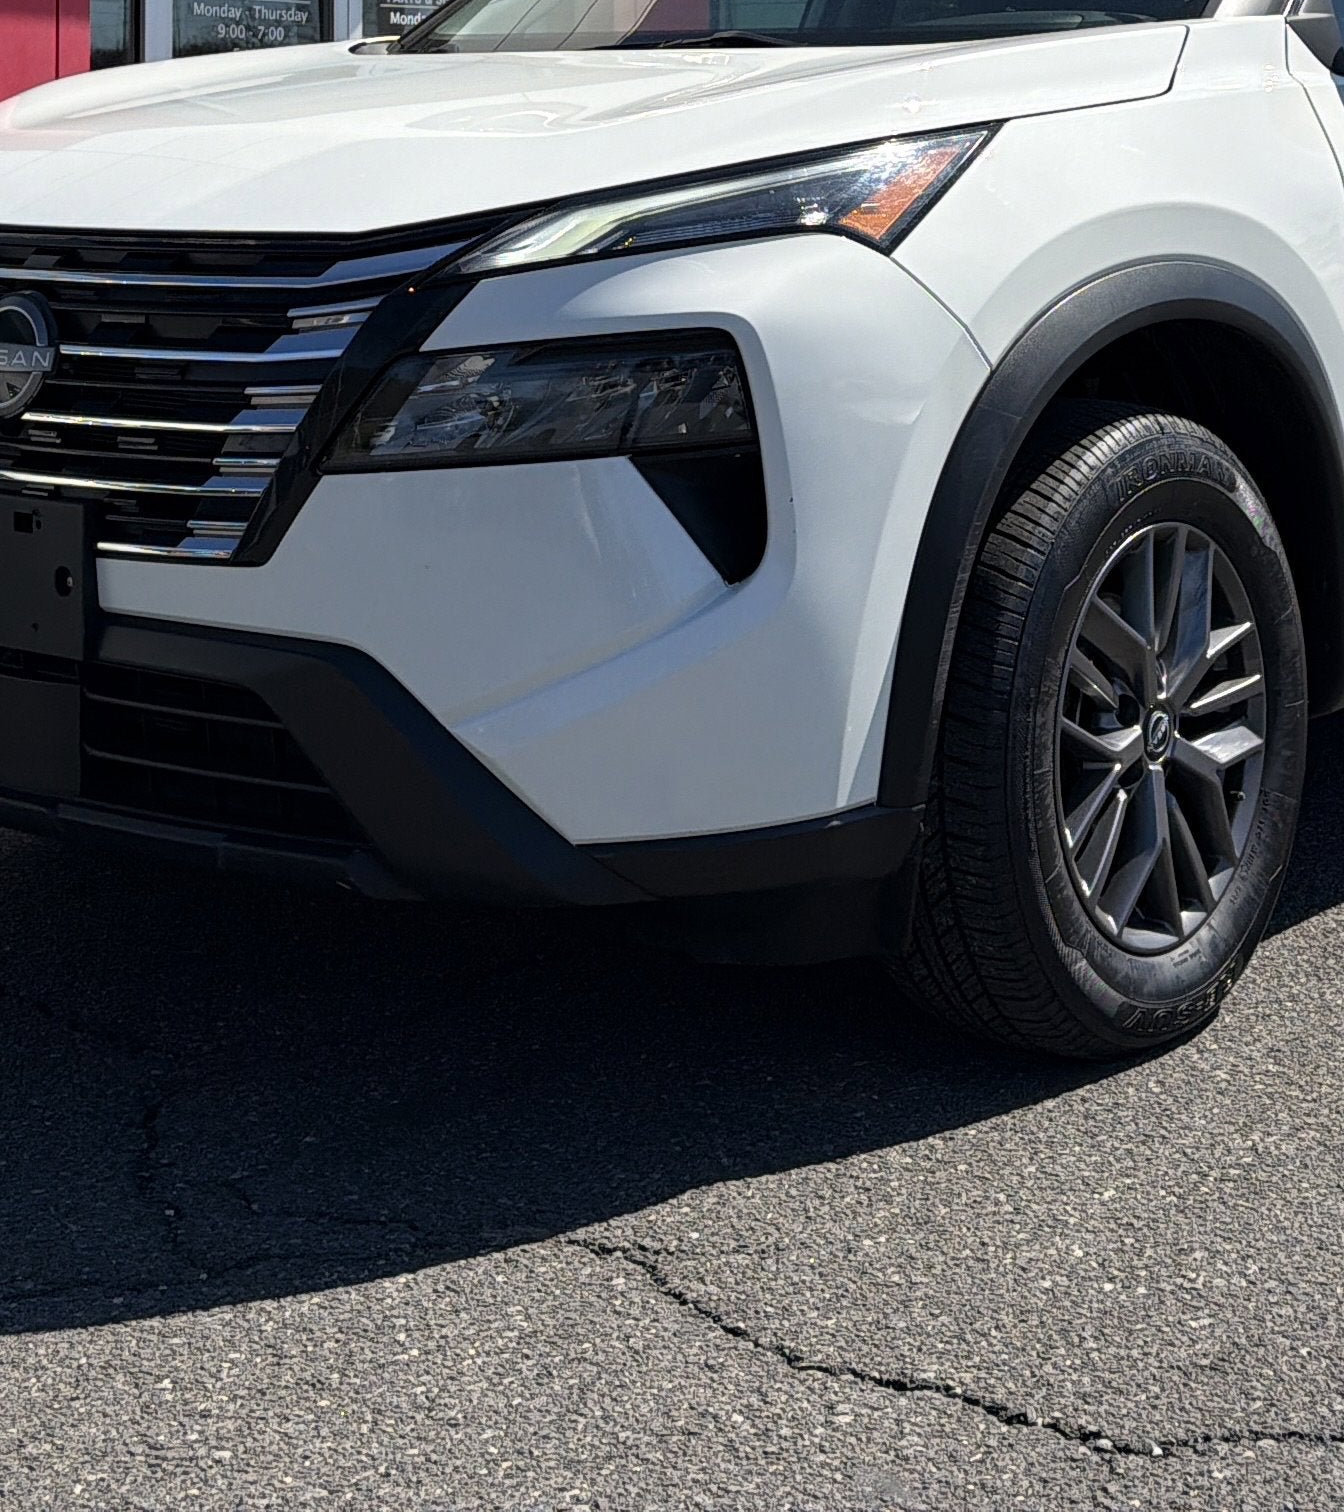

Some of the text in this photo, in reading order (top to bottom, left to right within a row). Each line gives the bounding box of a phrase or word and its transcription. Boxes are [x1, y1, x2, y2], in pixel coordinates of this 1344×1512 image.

[193, 2, 243, 21] Monday
[253, 5, 309, 24] Thursday
[217, 23, 246, 39] 9:00
[257, 25, 285, 41] 7:00
